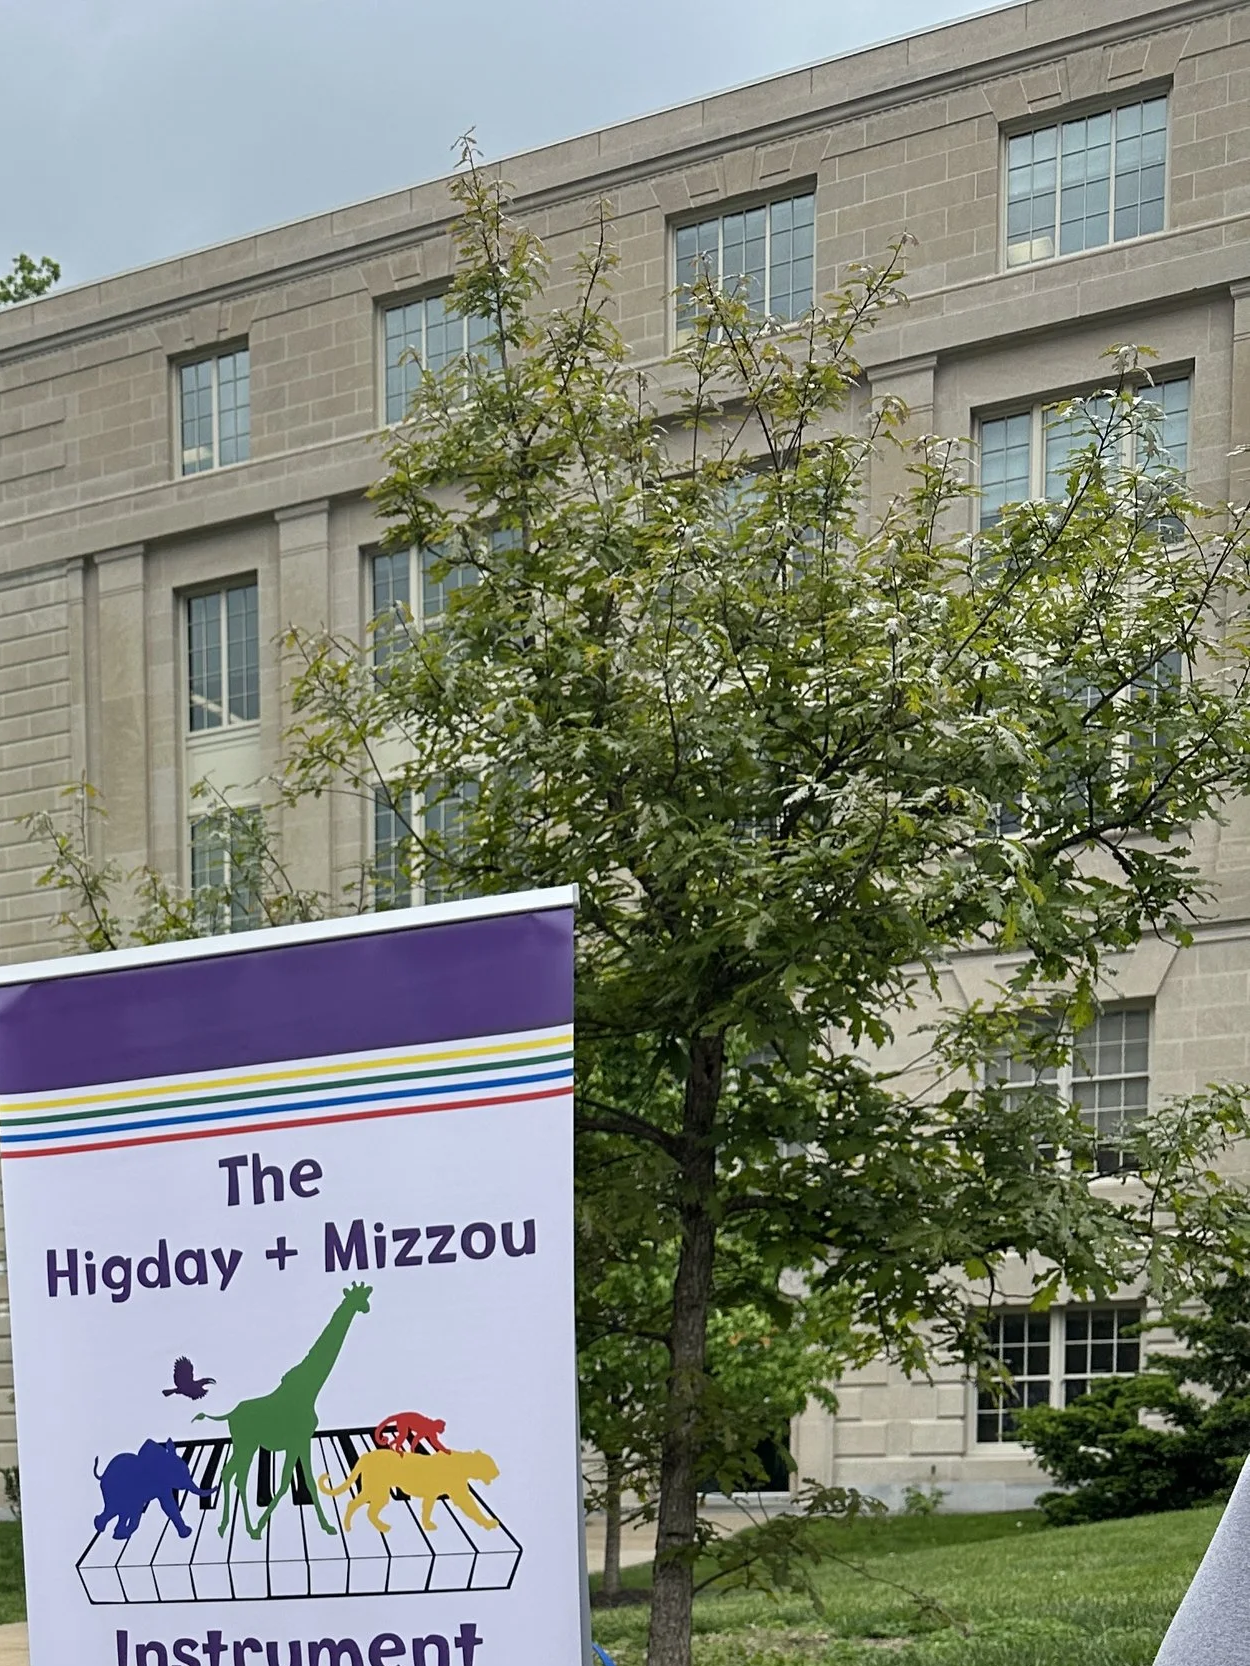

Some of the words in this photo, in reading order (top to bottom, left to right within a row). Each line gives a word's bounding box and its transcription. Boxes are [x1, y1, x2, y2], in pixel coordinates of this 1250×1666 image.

[218, 1152, 323, 1207] The
[46, 1238, 244, 1304] Higday
[265, 1236, 299, 1271] +
[324, 1218, 536, 1273] Mizzou
